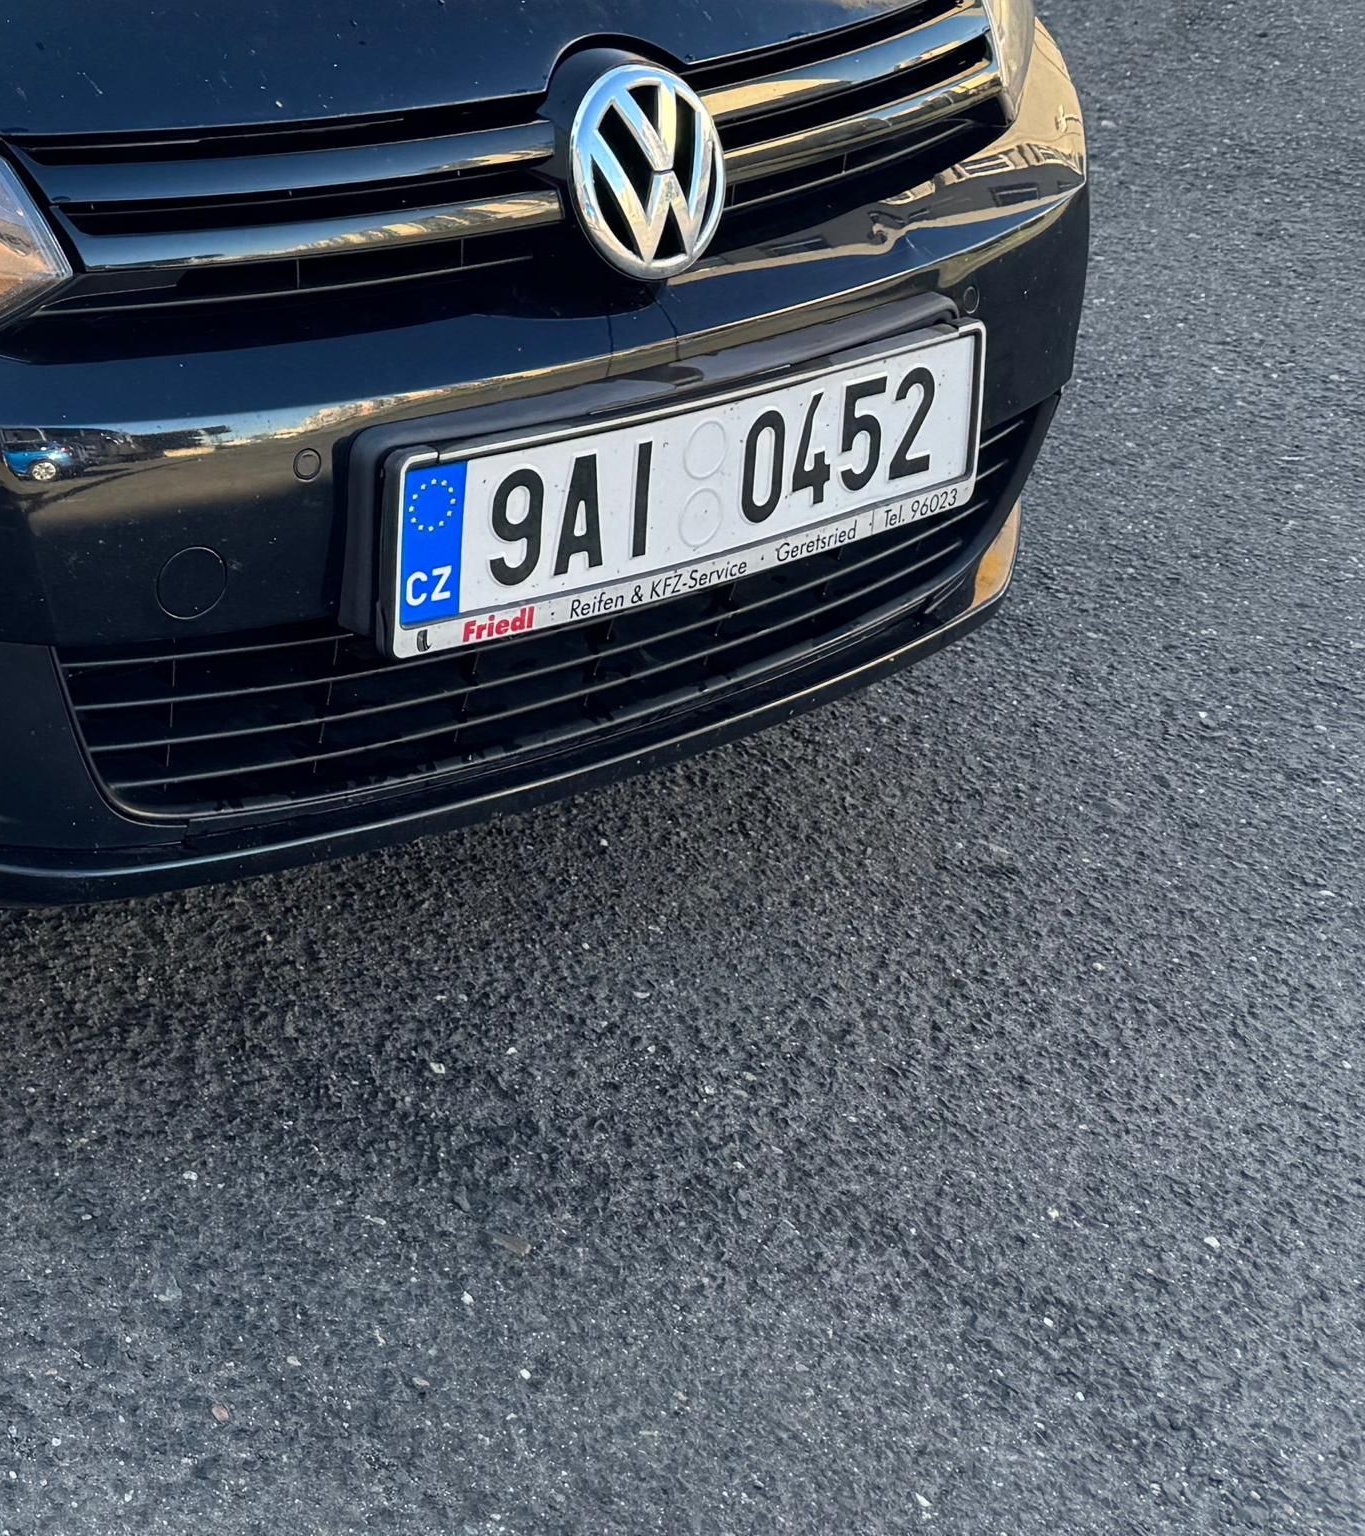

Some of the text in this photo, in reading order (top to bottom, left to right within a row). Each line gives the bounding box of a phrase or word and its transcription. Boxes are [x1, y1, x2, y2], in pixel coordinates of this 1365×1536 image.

[572, 65, 725, 278] VW
[462, 488, 958, 642] Friedl Reifen & KFZ-Service Geretsried Tel. 96023
[489, 367, 935, 586] 9AI 0452
[405, 565, 452, 606] CZ
